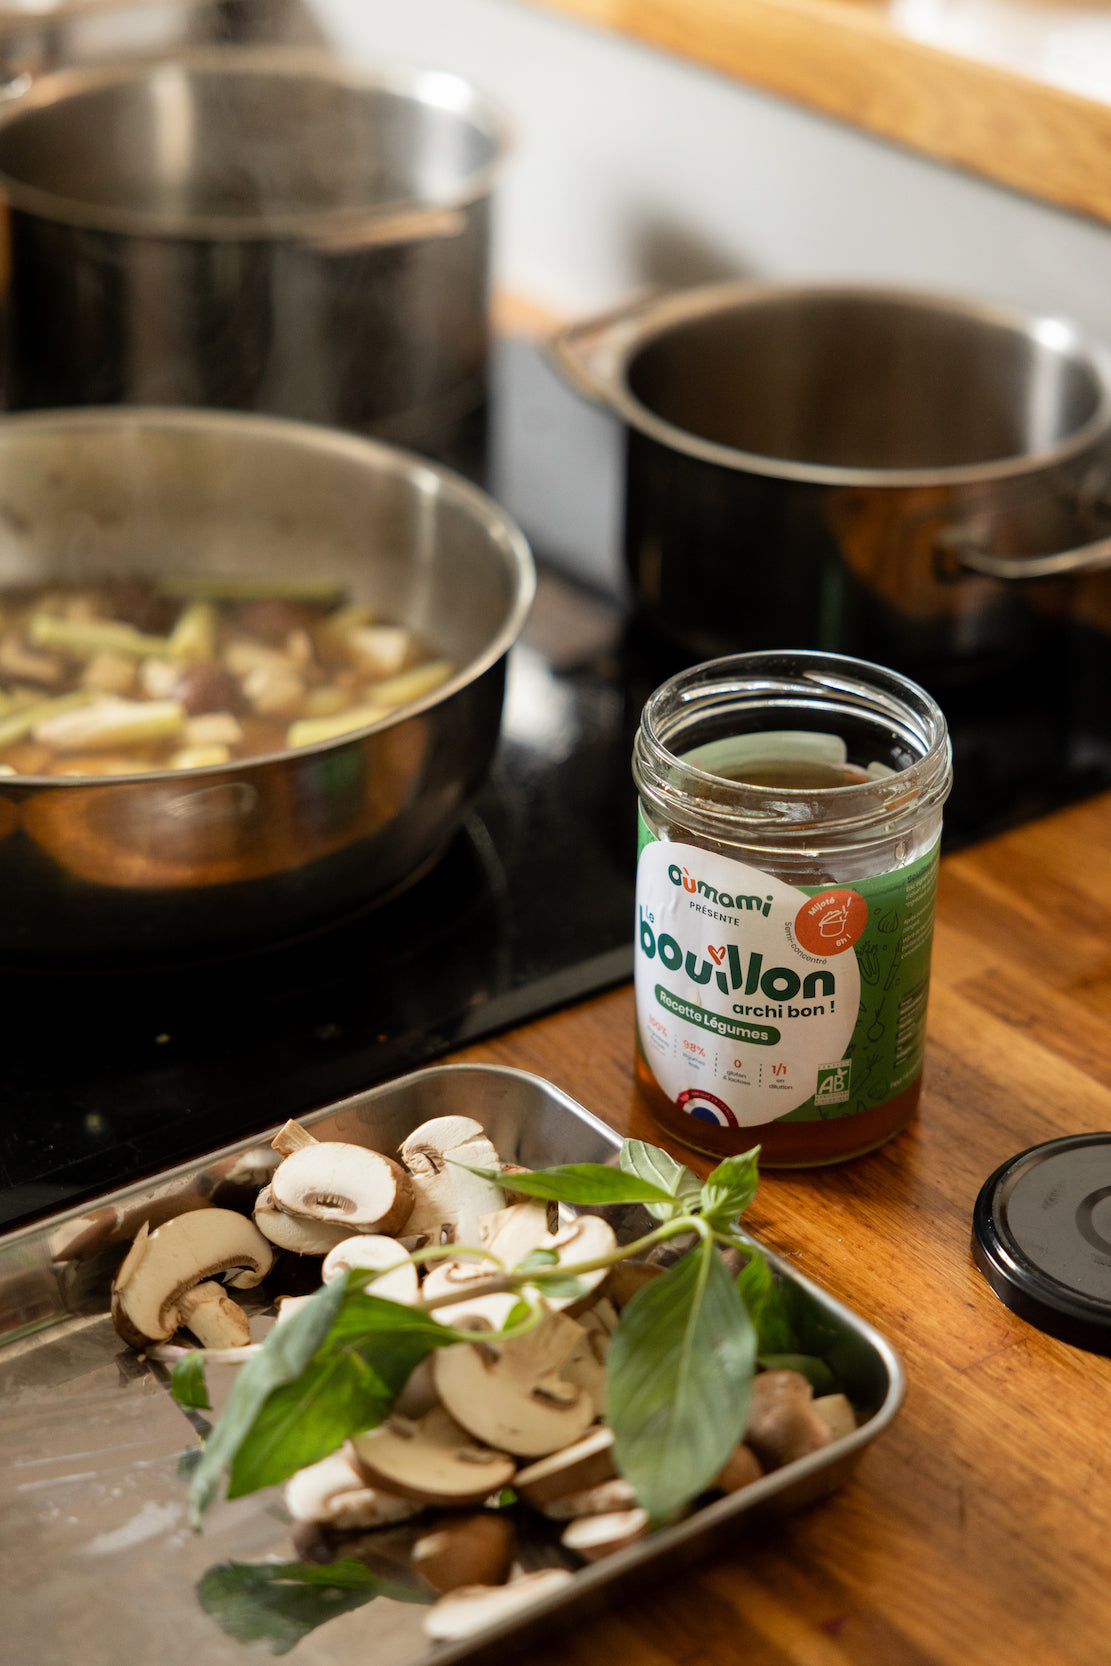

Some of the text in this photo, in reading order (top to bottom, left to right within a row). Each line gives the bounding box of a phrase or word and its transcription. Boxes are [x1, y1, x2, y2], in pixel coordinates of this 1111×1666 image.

[689, 901, 740, 926] PRÉSENTE
[639, 904, 835, 1002] bouillon
[659, 990, 702, 1022] Recette
[703, 1014, 769, 1041] Légumes
[732, 1000, 835, 1018] archi bon !
[683, 1039, 706, 1057] 98%
[733, 1058, 742, 1069] 0
[771, 1062, 787, 1077] 1/1
[818, 1075, 845, 1095] AB
